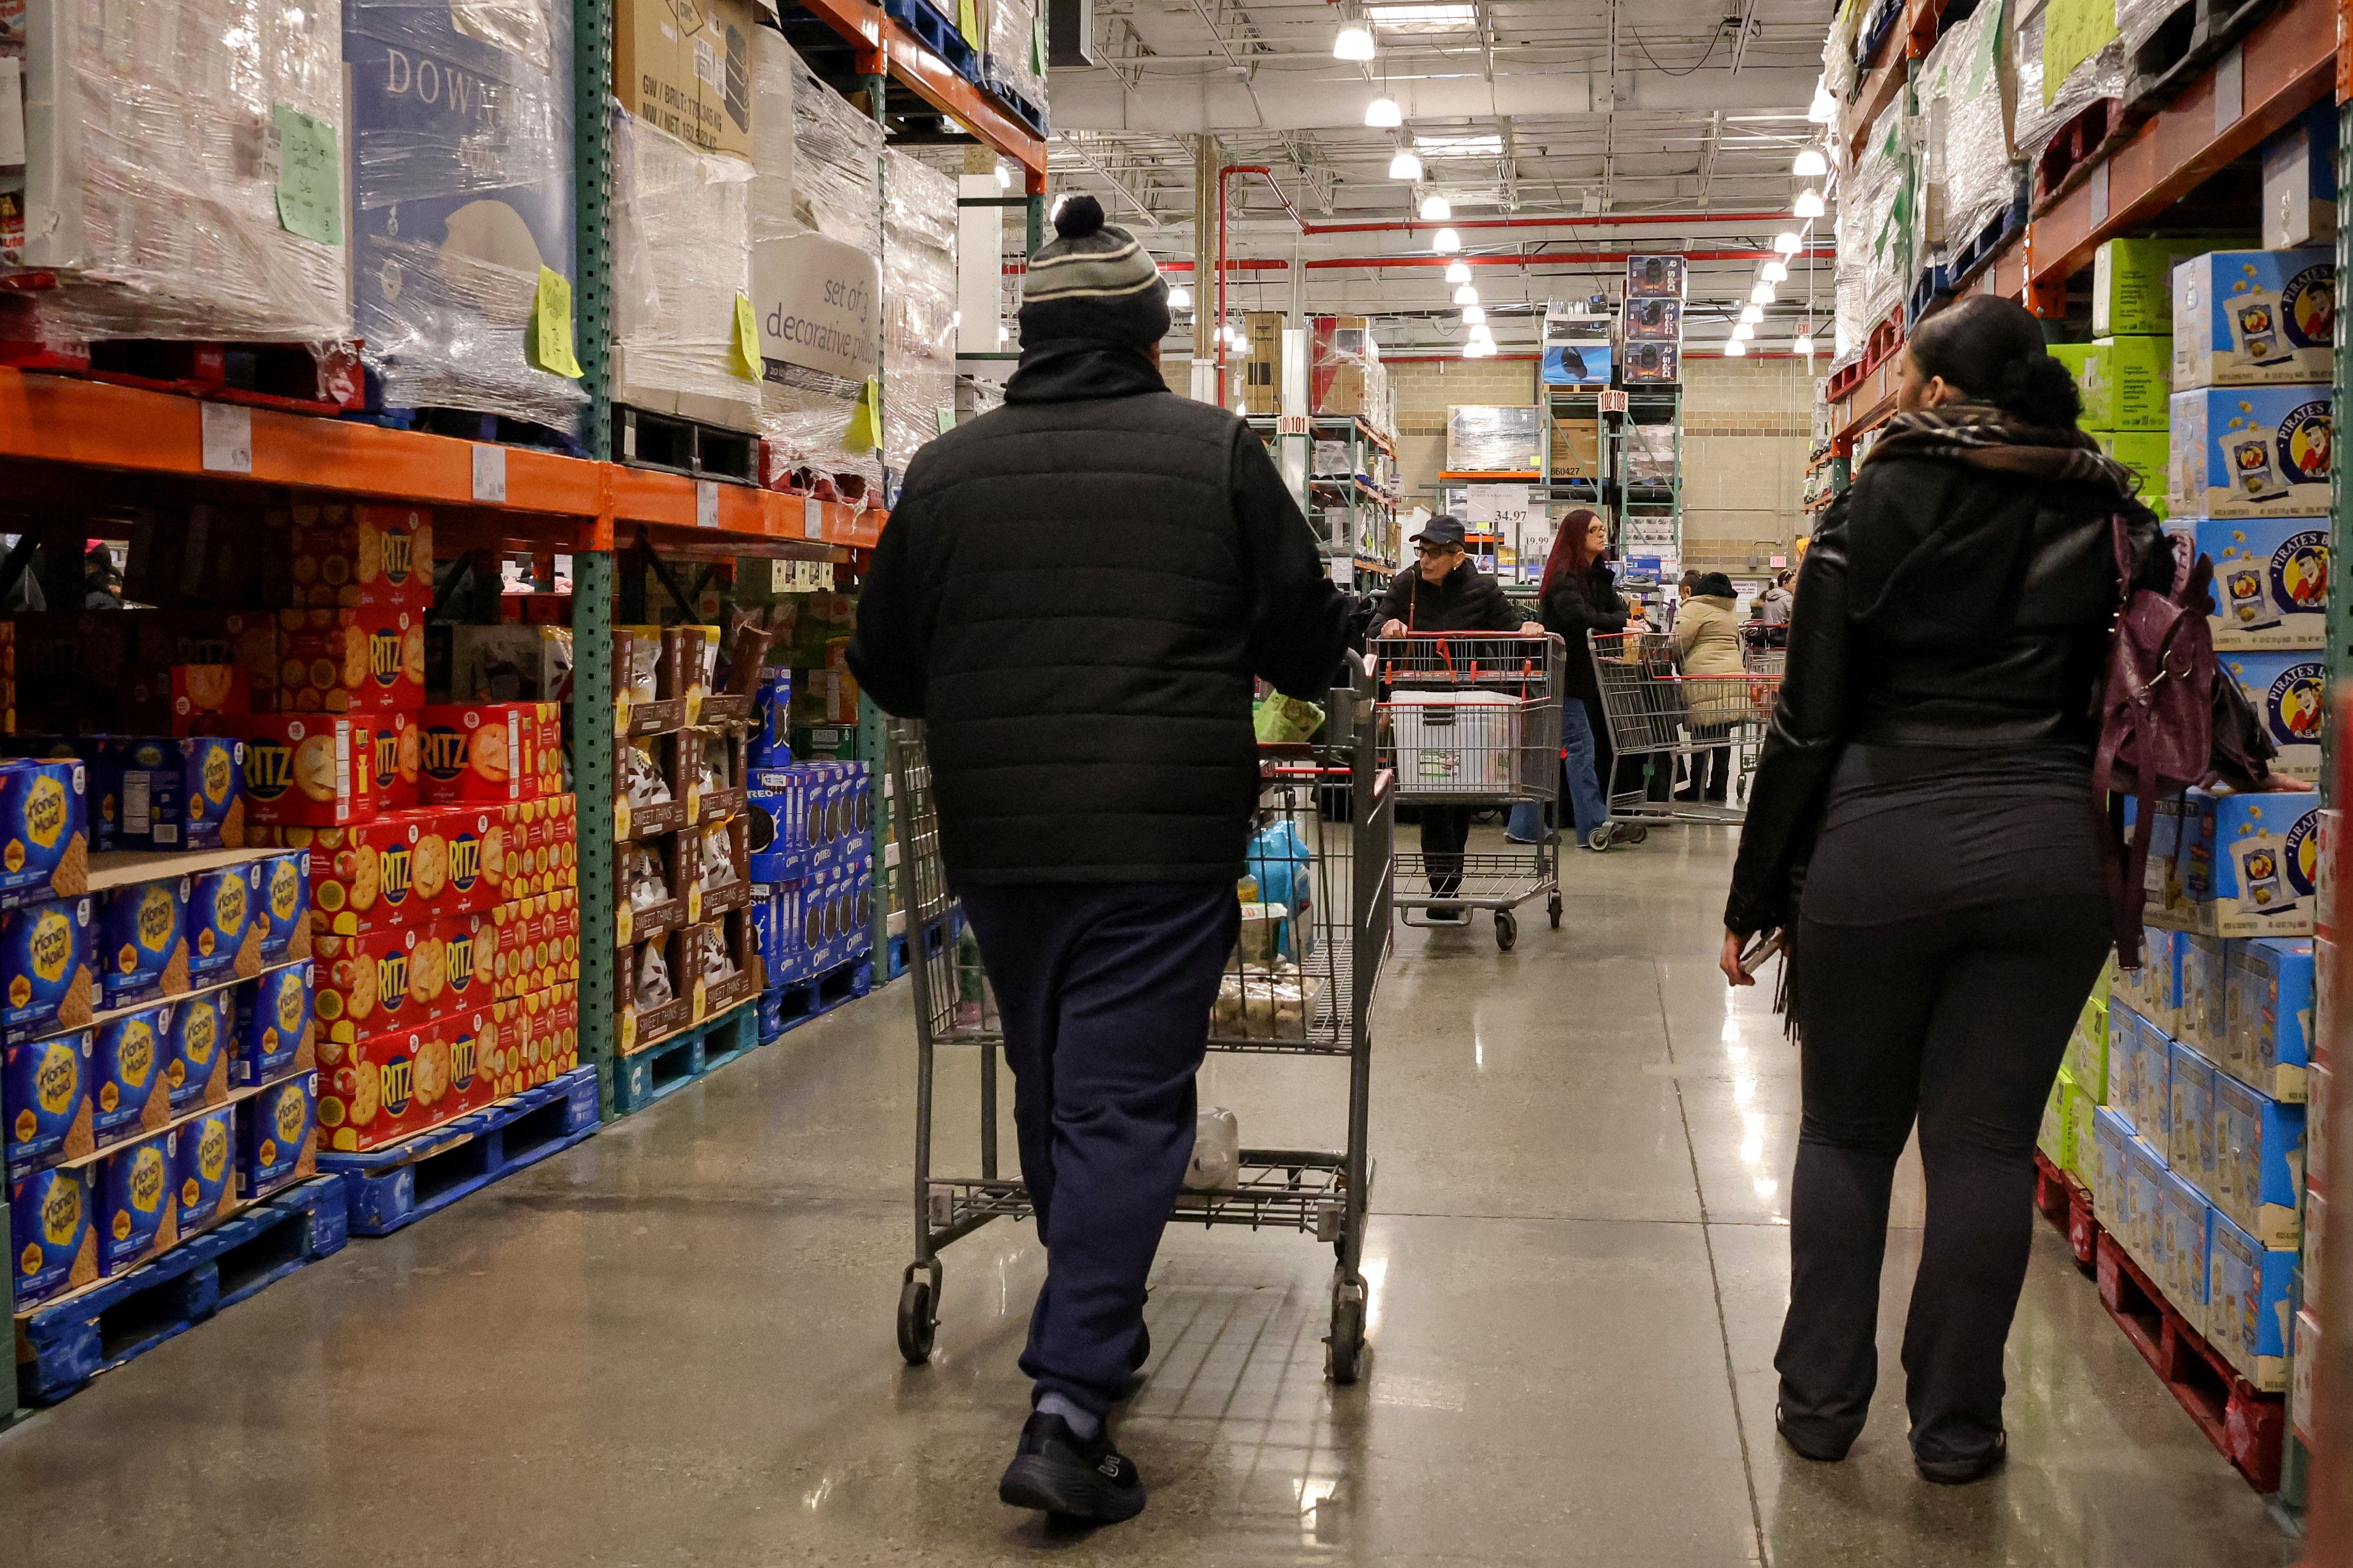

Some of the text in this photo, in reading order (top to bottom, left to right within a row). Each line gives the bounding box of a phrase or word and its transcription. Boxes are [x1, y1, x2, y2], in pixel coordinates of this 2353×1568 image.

[825, 279, 845, 307] set
[848, 280, 864, 312] of
[767, 302, 851, 357] decorative
[1601, 392, 1612, 411] 102
[1613, 392, 1625, 410] 103
[1291, 417, 1305, 433] 101
[1495, 511, 1527, 521] 34.97
[382, 532, 411, 571] RITZ
[1526, 537, 1549, 545] 19.99
[2272, 534, 2317, 569] PIRATE'S
[1772, 557, 1785, 566] EXIT
[370, 634, 402, 675] RITZ
[2269, 666, 2315, 701] PIRATE'S
[417, 731, 469, 770] RITZ
[28, 792, 61, 817] Honey
[702, 796, 719, 812] SWEET
[747, 790, 773, 798] REO
[35, 812, 60, 836] Maid
[633, 809, 653, 826] SWEET
[814, 849, 830, 867] OREO
[847, 838, 862, 855] OREO
[449, 839, 480, 881] RITZ
[380, 851, 411, 894] RITZ
[216, 887, 242, 910] Honey
[270, 875, 295, 899] Honey
[704, 890, 725, 909] SWEET
[140, 902, 170, 926] Honey
[222, 904, 241, 927] Maid
[635, 912, 655, 931] SWEET
[34, 927, 66, 956] Honey
[145, 919, 168, 942] Maid
[847, 932, 862, 951] OREO
[41, 945, 65, 971] Maid
[447, 940, 475, 982] RITZ
[813, 948, 829, 967] OREO
[378, 956, 409, 1001] RITZ
[708, 984, 726, 1004] SWEET
[188, 1015, 212, 1038] Honey
[640, 1012, 660, 1033] SWEET
[121, 1036, 150, 1060] Honey
[192, 1033, 211, 1055] Maid
[40, 1059, 72, 1086] Honey
[126, 1052, 148, 1078] Maid
[451, 1039, 476, 1087] RITZ
[46, 1076, 71, 1105] Maid
[381, 1060, 413, 1106] RITZ
[278, 1098, 302, 1119] Honey
[283, 1113, 300, 1135] Maid
[200, 1132, 224, 1157] Honey
[205, 1146, 222, 1171] Maid
[133, 1160, 161, 1187] Honey
[138, 1177, 159, 1204] Maid
[44, 1191, 76, 1219] Honey
[50, 1207, 75, 1237] Maid
